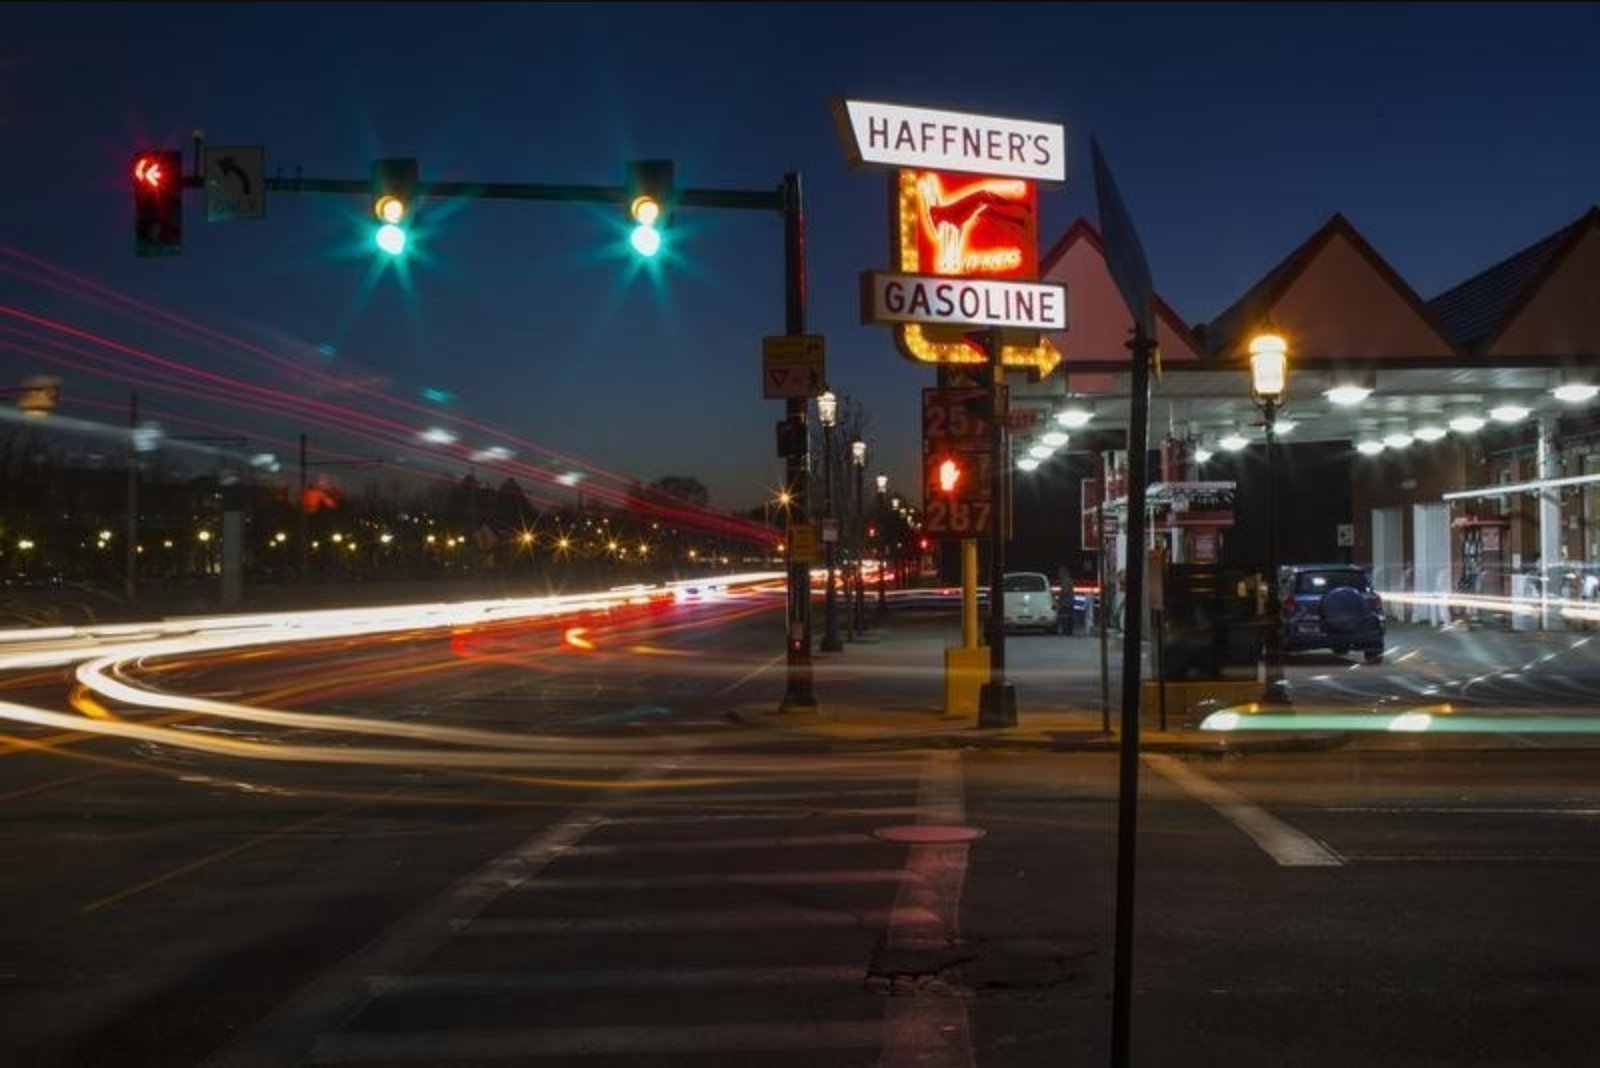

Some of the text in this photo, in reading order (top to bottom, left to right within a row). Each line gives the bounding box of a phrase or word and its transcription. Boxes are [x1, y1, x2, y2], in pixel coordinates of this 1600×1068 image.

[868, 115, 1051, 166] HAFFNER'S
[884, 282, 1056, 323] GASOLINE
[926, 501, 991, 533] 287
